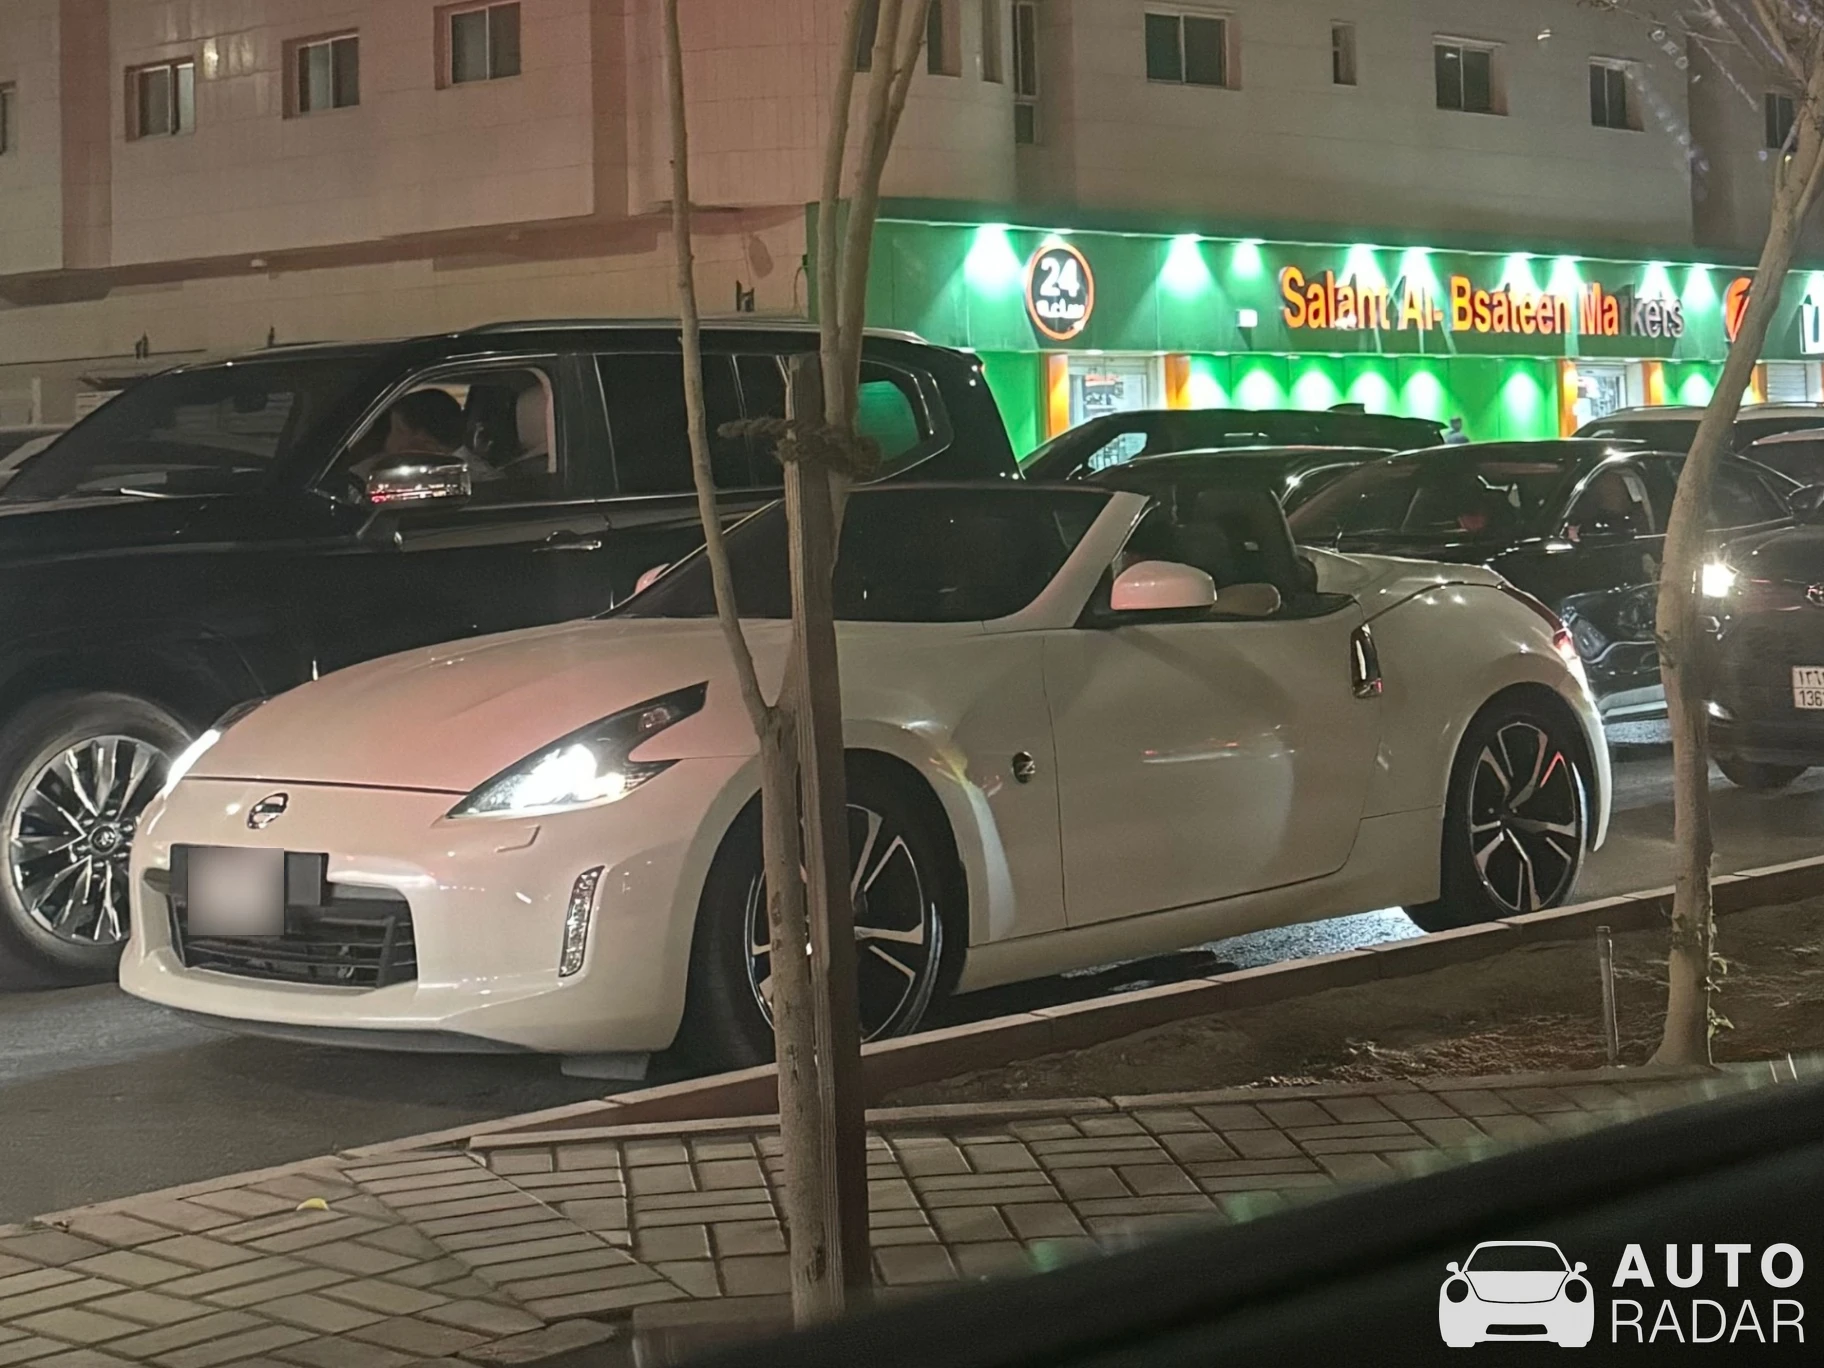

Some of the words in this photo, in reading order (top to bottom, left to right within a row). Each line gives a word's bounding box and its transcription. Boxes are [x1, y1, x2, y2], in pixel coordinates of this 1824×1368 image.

[1040, 257, 1080, 297] 24
[1450, 275, 1571, 335] Bsateen
[1578, 281, 1684, 338] Markets
[1799, 670, 1824, 685] ١٣٦
[1799, 690, 1824, 706] 136
